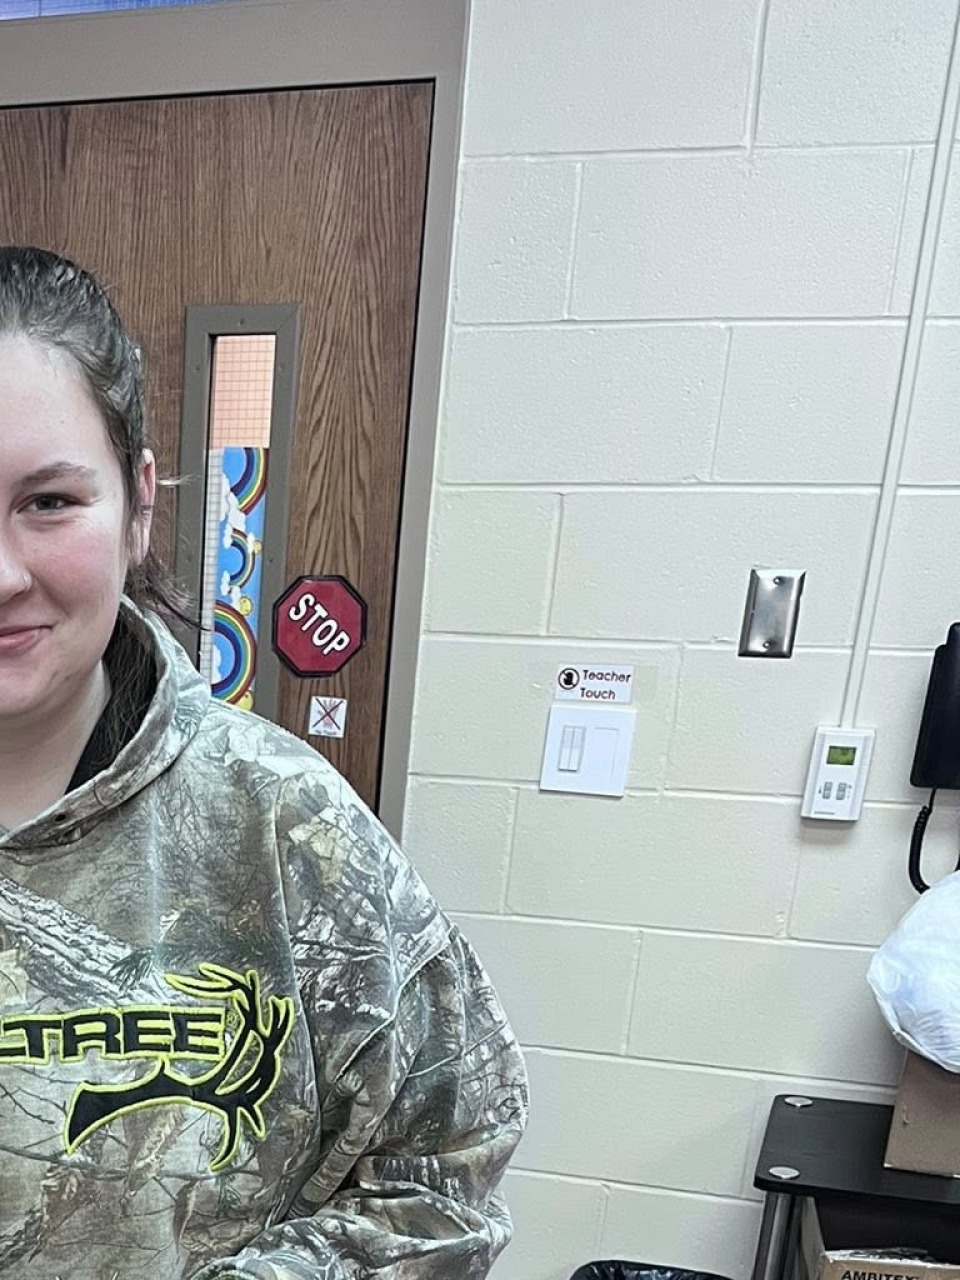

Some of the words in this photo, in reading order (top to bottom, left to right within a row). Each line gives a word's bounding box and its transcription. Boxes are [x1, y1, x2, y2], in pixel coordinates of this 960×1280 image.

[288, 593, 351, 655] STOP
[582, 669, 631, 683] Teacher
[580, 687, 616, 700] Touch
